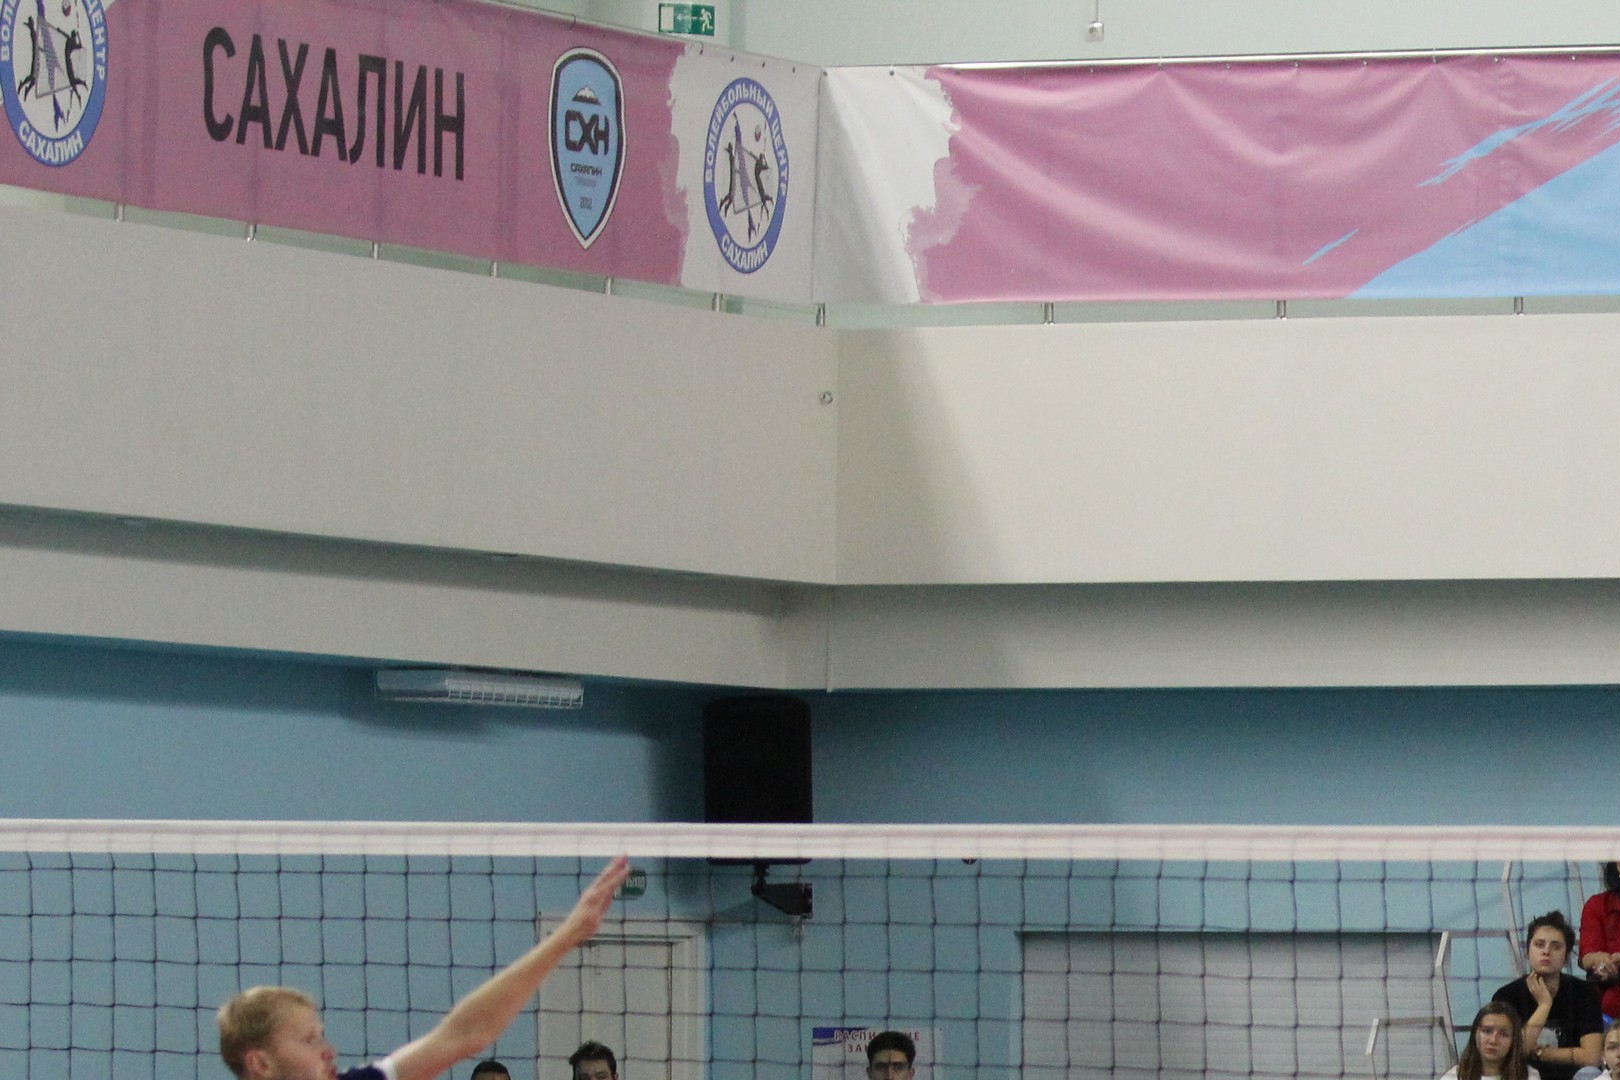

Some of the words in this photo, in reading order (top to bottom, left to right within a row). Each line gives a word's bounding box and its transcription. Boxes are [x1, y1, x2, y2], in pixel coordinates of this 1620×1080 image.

[19, 121, 84, 163] САХАЛИН
[203, 27, 464, 181] САХАЛИН
[705, 82, 774, 183] ВОЛЕЙБОЛЬНЫЙ
[771, 117, 788, 196] ЦЕНТР
[722, 233, 768, 271] САХАЛИН
